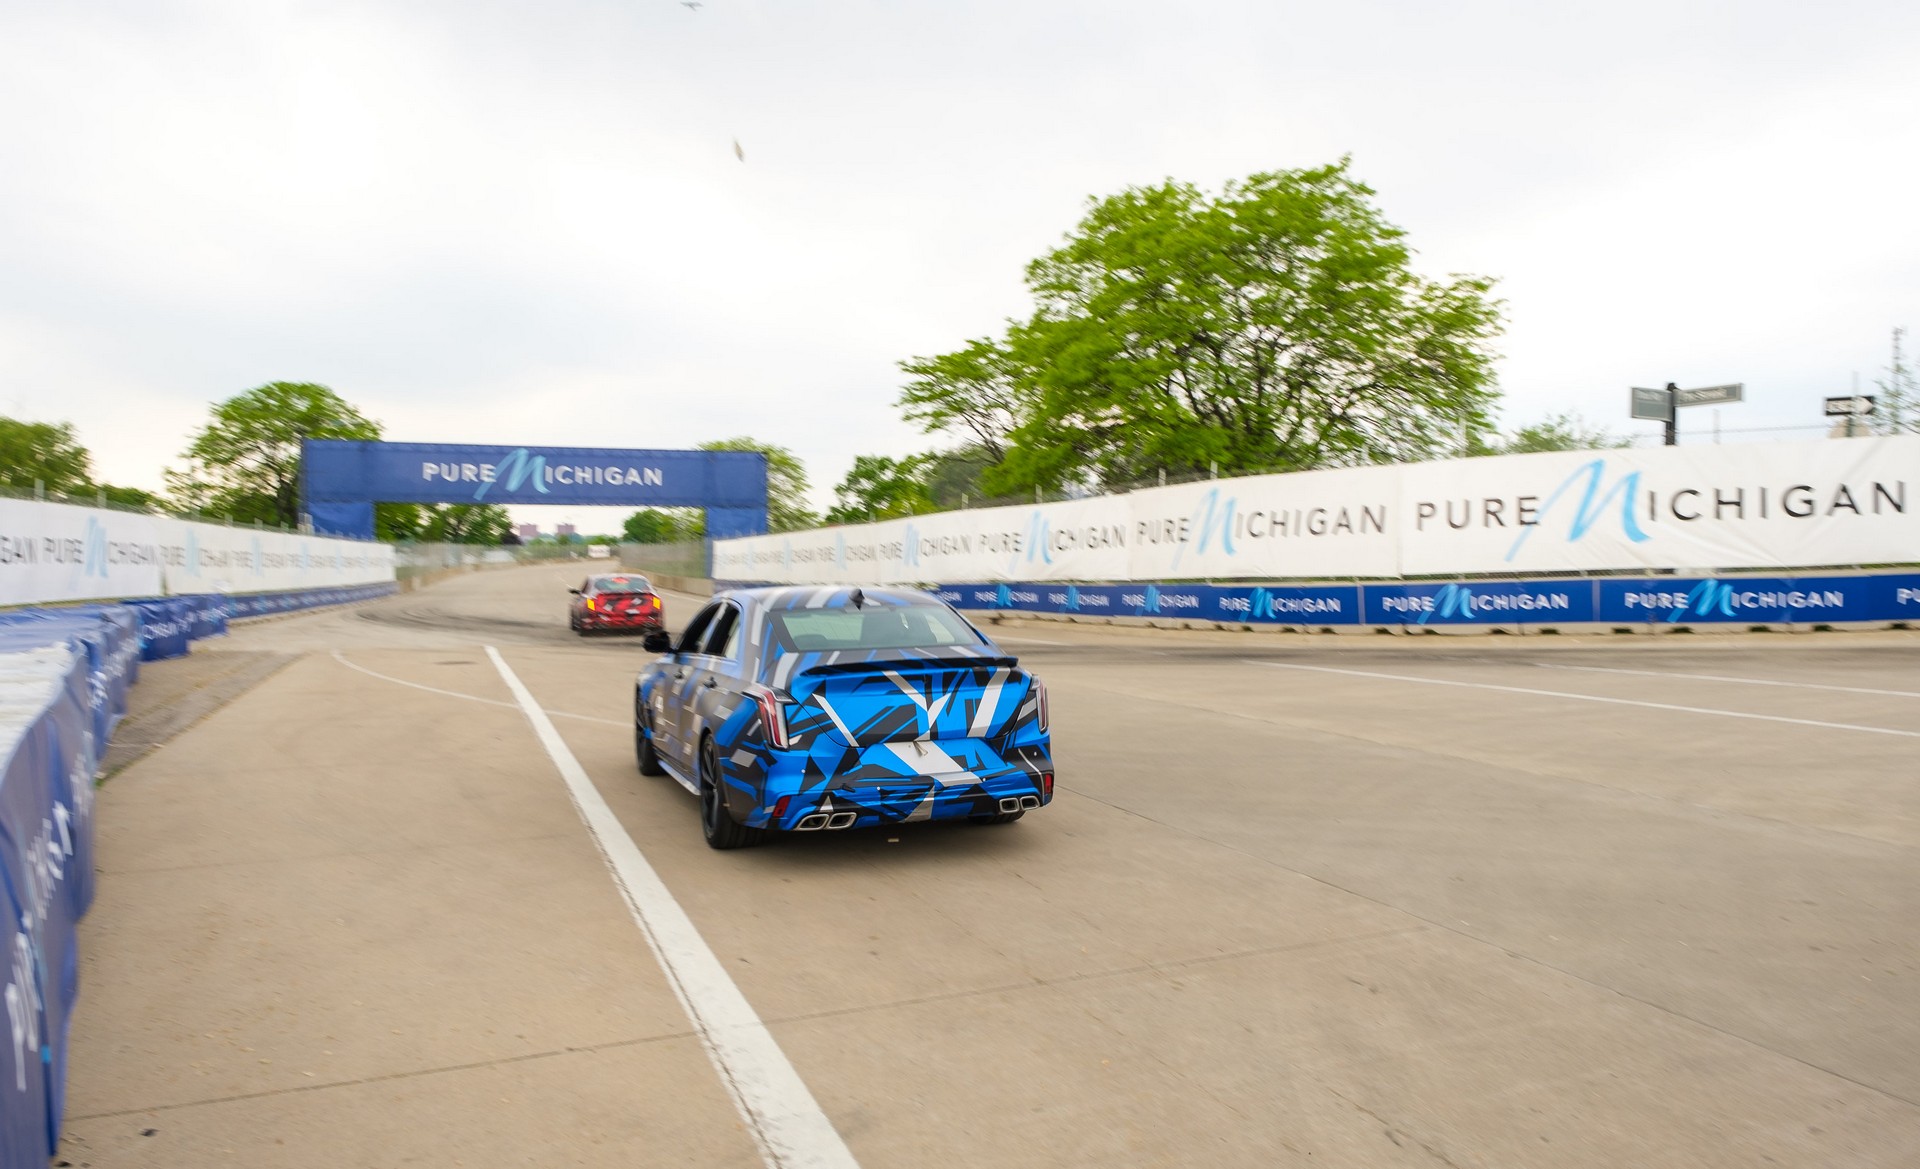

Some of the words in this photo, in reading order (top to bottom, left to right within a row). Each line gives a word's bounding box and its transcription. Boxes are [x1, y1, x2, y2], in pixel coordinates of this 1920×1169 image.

[422, 462, 496, 483] PURE
[473, 448, 663, 500] MICHIGAN
[1136, 517, 1190, 545] PURE
[1170, 487, 1386, 570] MICHIGAN
[1416, 495, 1540, 531] PURE
[1505, 459, 1907, 562] MICHIGAN
[43, 536, 84, 564] PURE
[979, 532, 1022, 552] PURE
[1008, 510, 1126, 574] MICHIGAN
[1122, 593, 1145, 607] PURE
[1135, 584, 1199, 616] MICHIGAN
[1219, 597, 1251, 612] PURE
[1239, 586, 1341, 622] MICHIGAN
[1383, 596, 1435, 612] PURE
[1417, 582, 1569, 625] MICHIGAN
[1625, 591, 1689, 609] PURE
[1667, 578, 1843, 623] MICHIGAN
